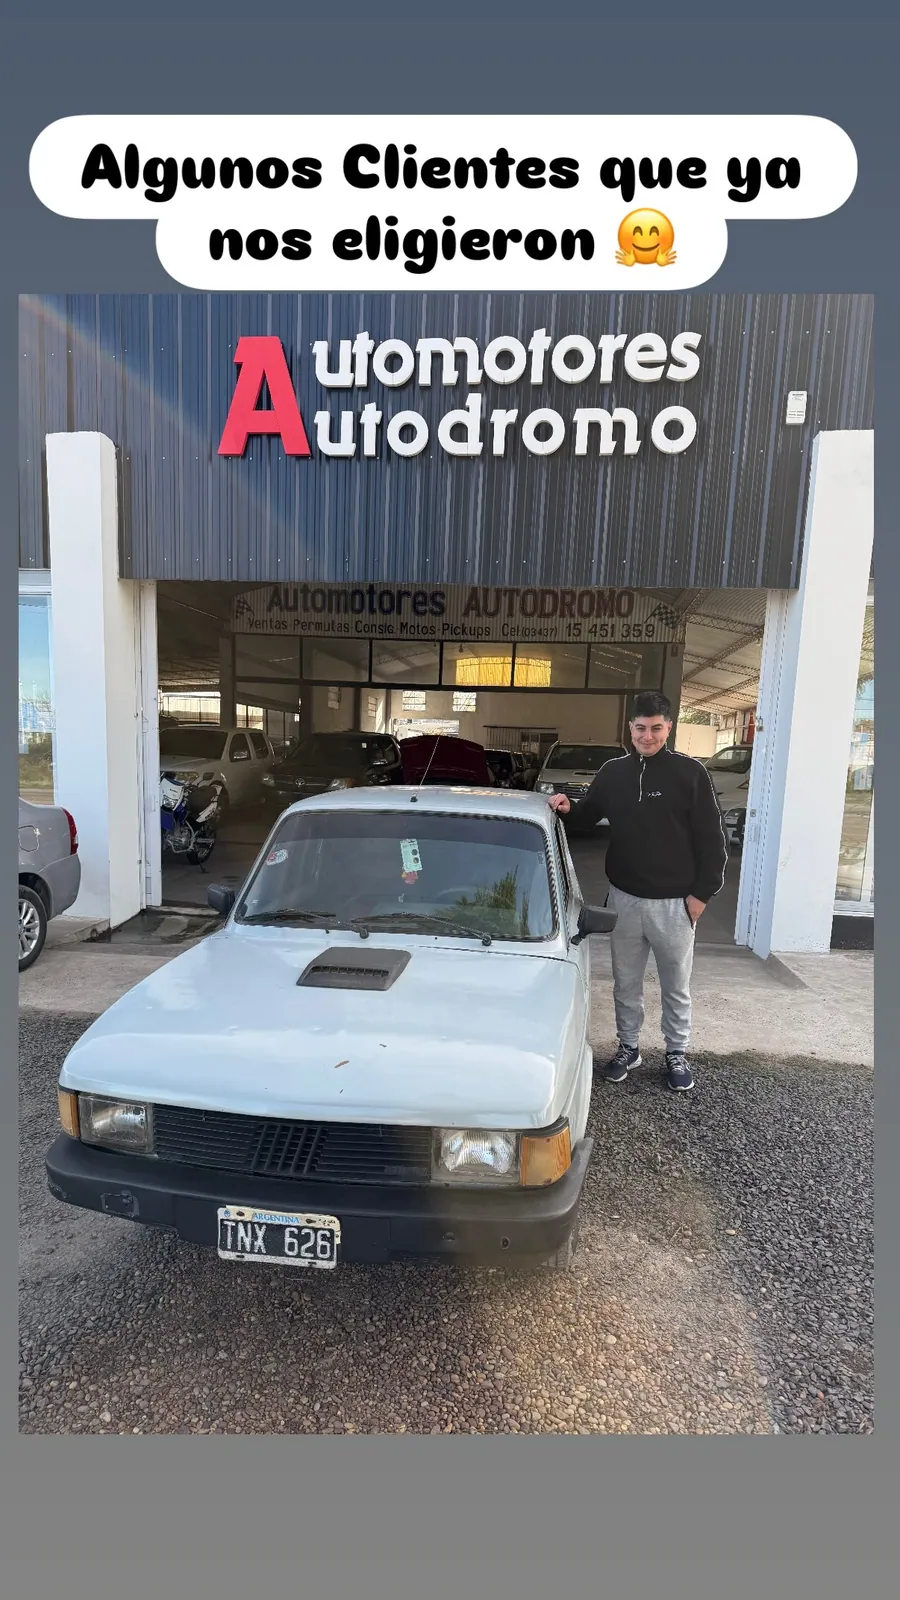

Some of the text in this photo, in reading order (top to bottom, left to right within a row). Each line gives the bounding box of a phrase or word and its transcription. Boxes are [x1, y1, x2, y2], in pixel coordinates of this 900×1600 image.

[268, 583, 635, 619] Automotores AUTODROMO
[248, 617, 288, 630] Ventas
[293, 618, 350, 632] Permutas
[400, 621, 436, 635] Motos
[442, 623, 491, 638] Pickups
[566, 624, 582, 637] 15
[589, 624, 615, 638] 451
[621, 624, 655, 638] 359
[252, 1212, 300, 1224] ARGENTINA
[223, 1220, 331, 1259] TNX 626
